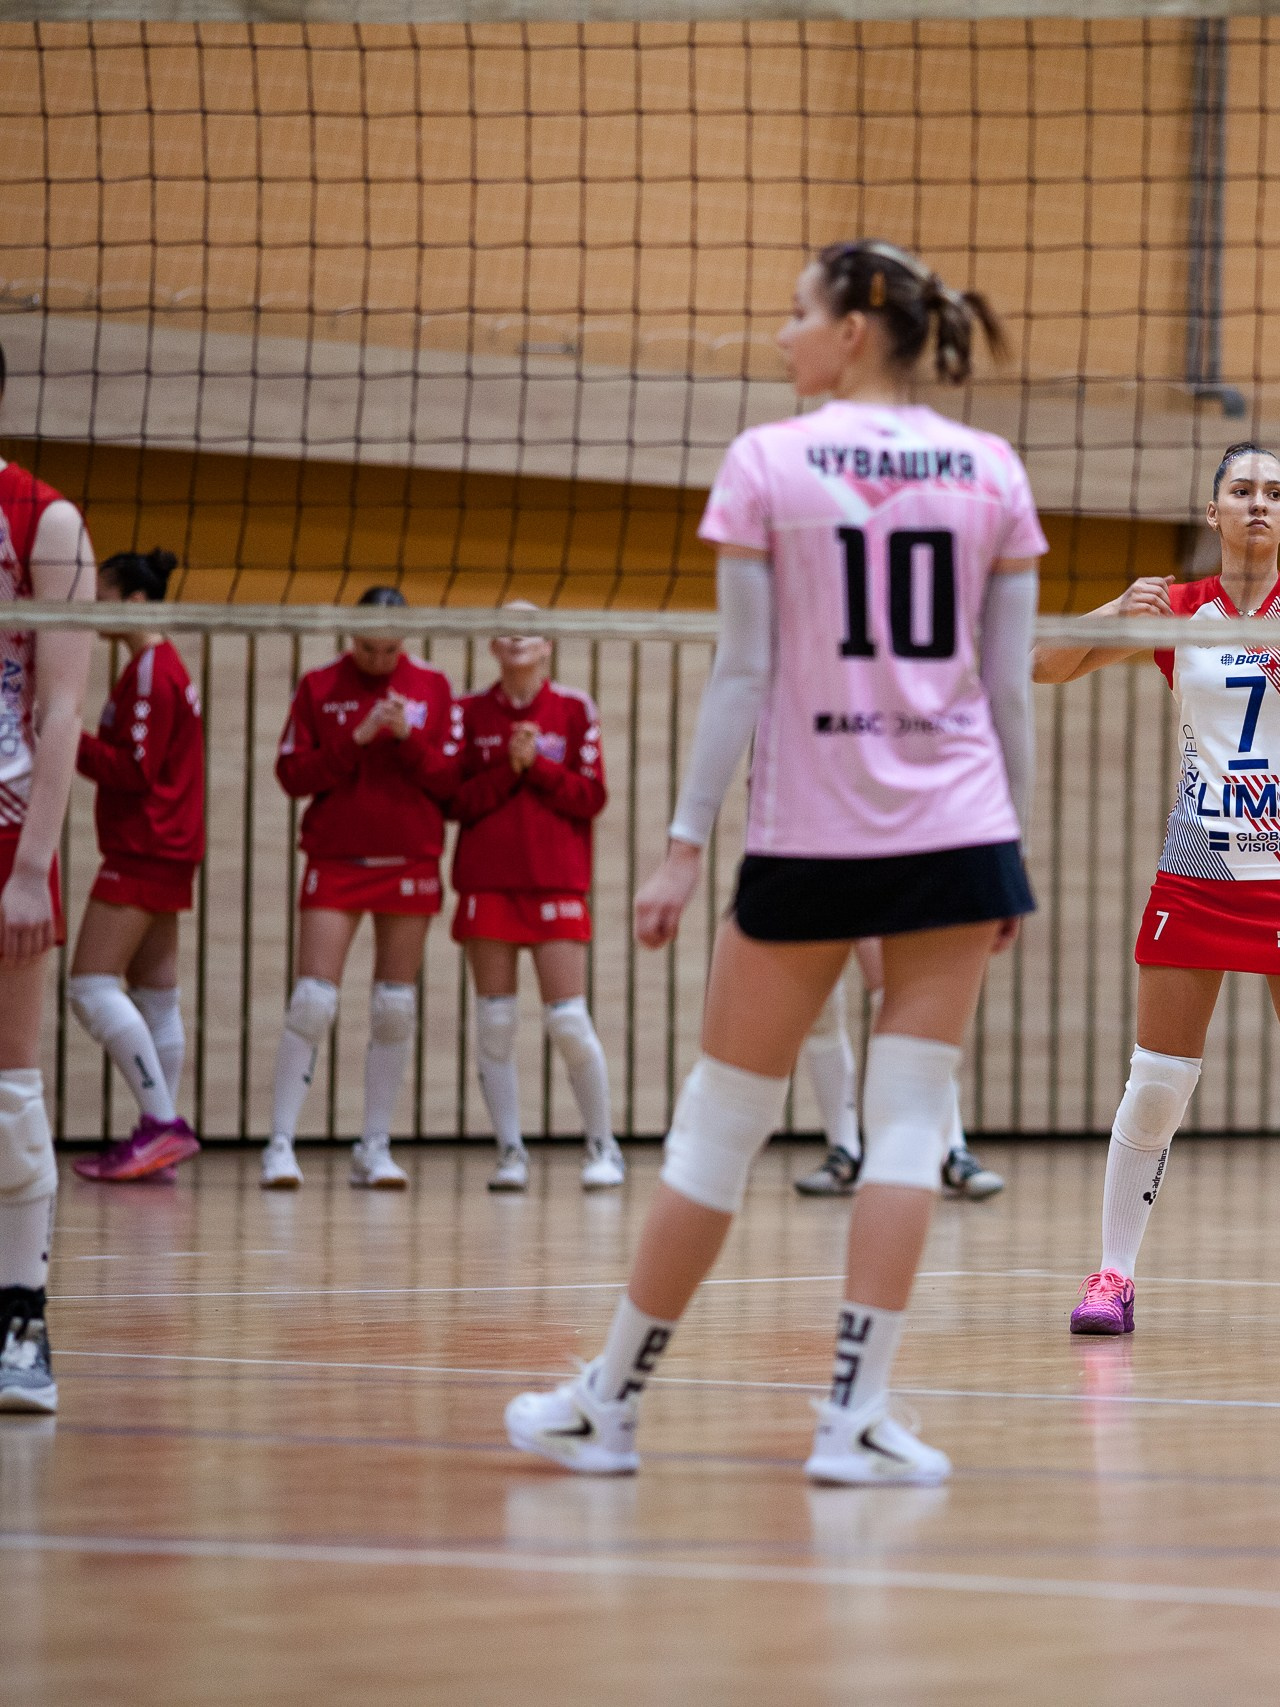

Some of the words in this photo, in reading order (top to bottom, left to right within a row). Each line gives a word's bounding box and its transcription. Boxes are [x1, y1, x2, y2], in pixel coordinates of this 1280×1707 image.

[807, 446, 977, 481] ЧУВАШИЯ
[836, 525, 956, 659] 10
[1235, 653, 1270, 665] ВФВ
[1225, 676, 1267, 753] 7
[1153, 910, 1169, 940] 7
